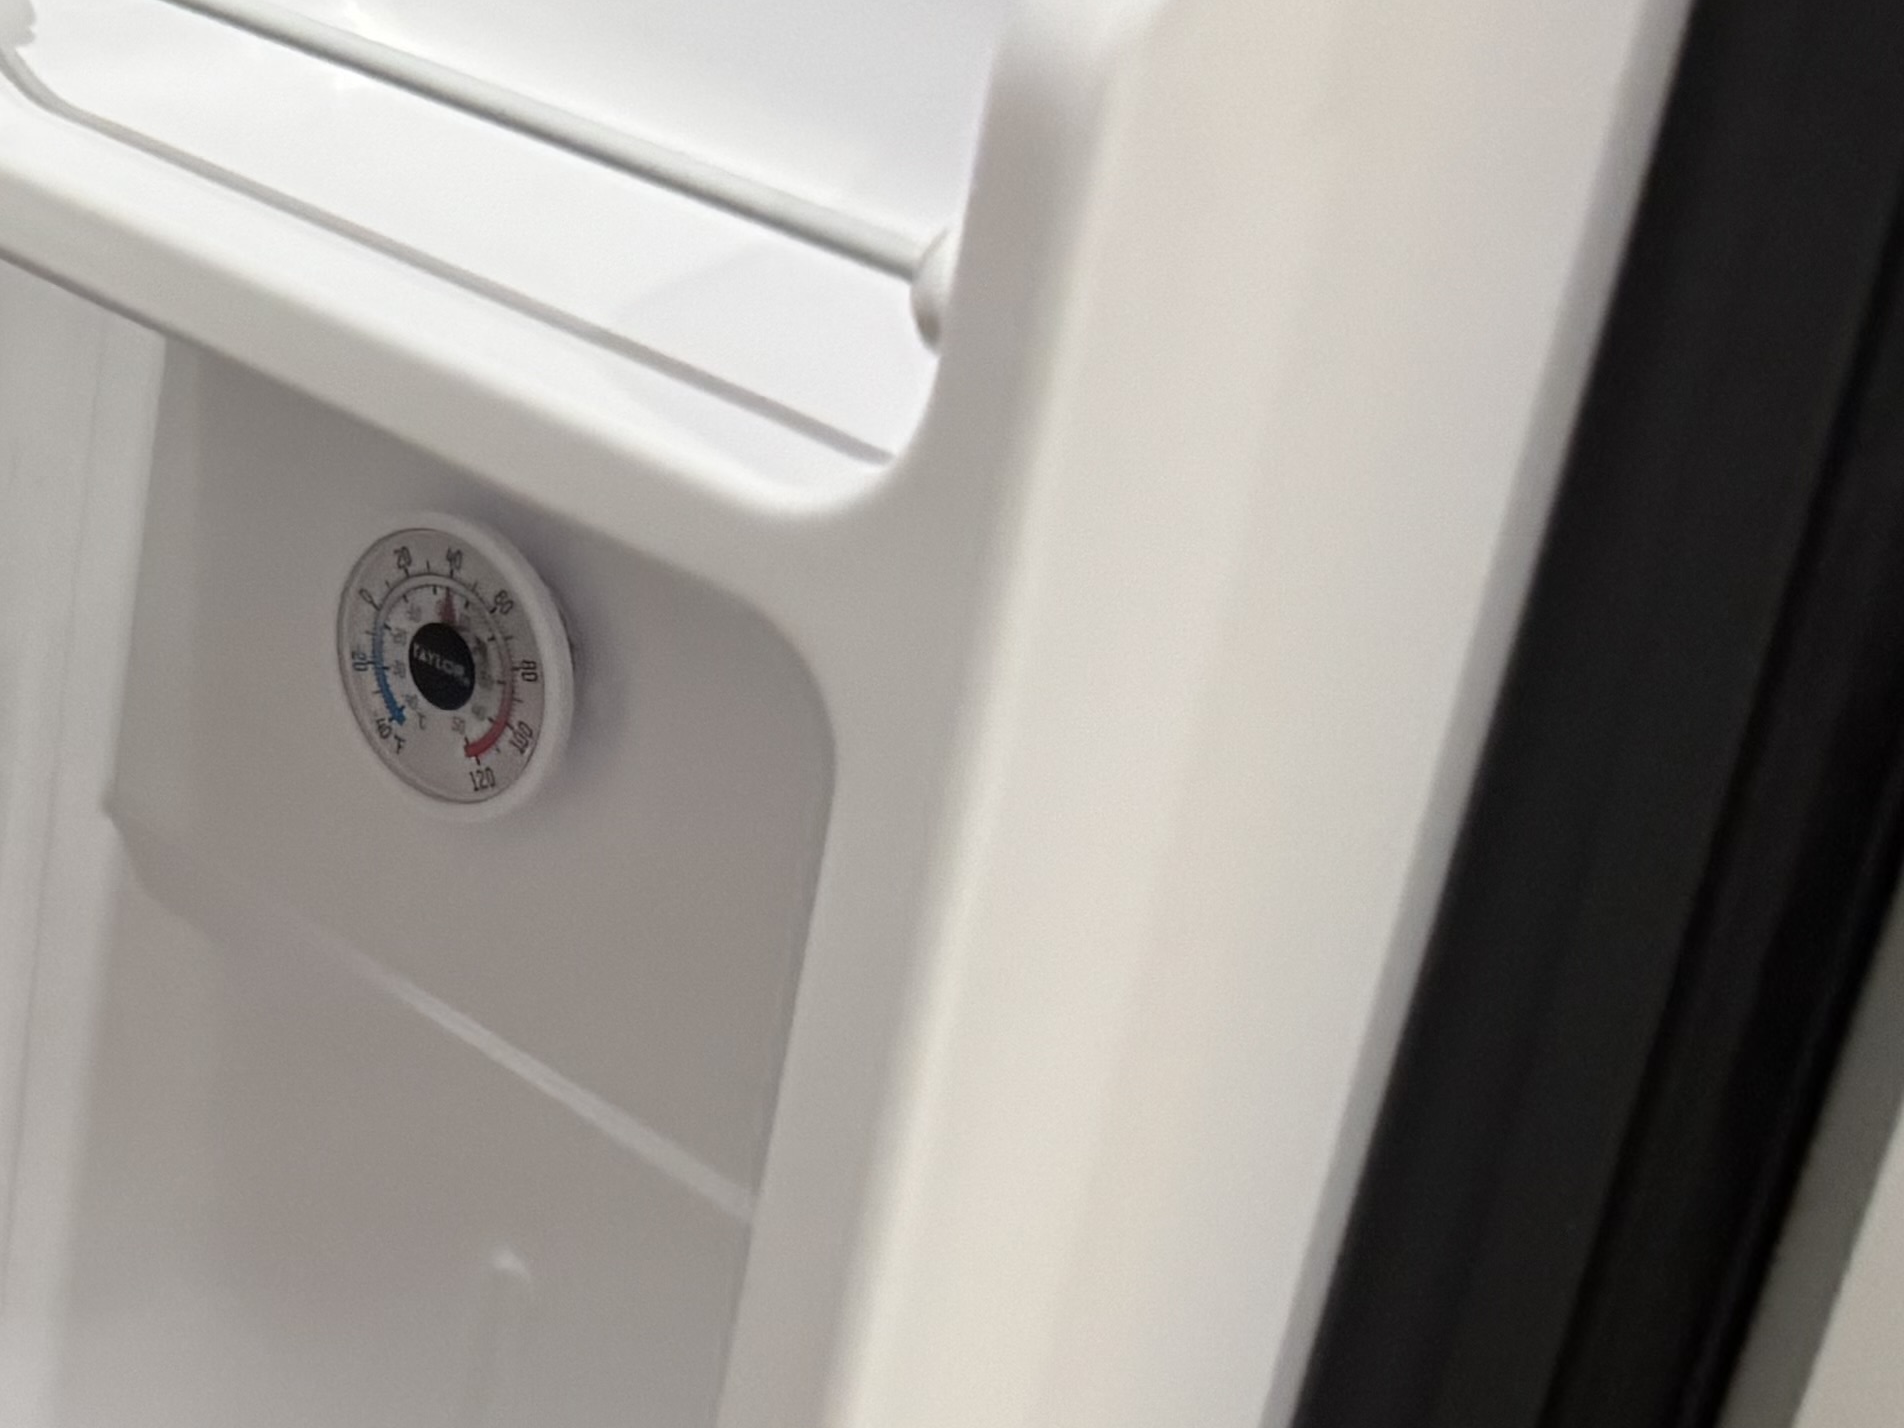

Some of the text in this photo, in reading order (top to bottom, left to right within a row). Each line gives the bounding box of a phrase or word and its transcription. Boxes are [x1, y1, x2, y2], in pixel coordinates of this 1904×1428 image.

[393, 545, 412, 570] 20
[446, 547, 464, 571] 40
[412, 641, 466, 677] TAYLOR
[520, 659, 539, 683] 80
[509, 720, 534, 755] 100
[468, 766, 497, 792] 120
